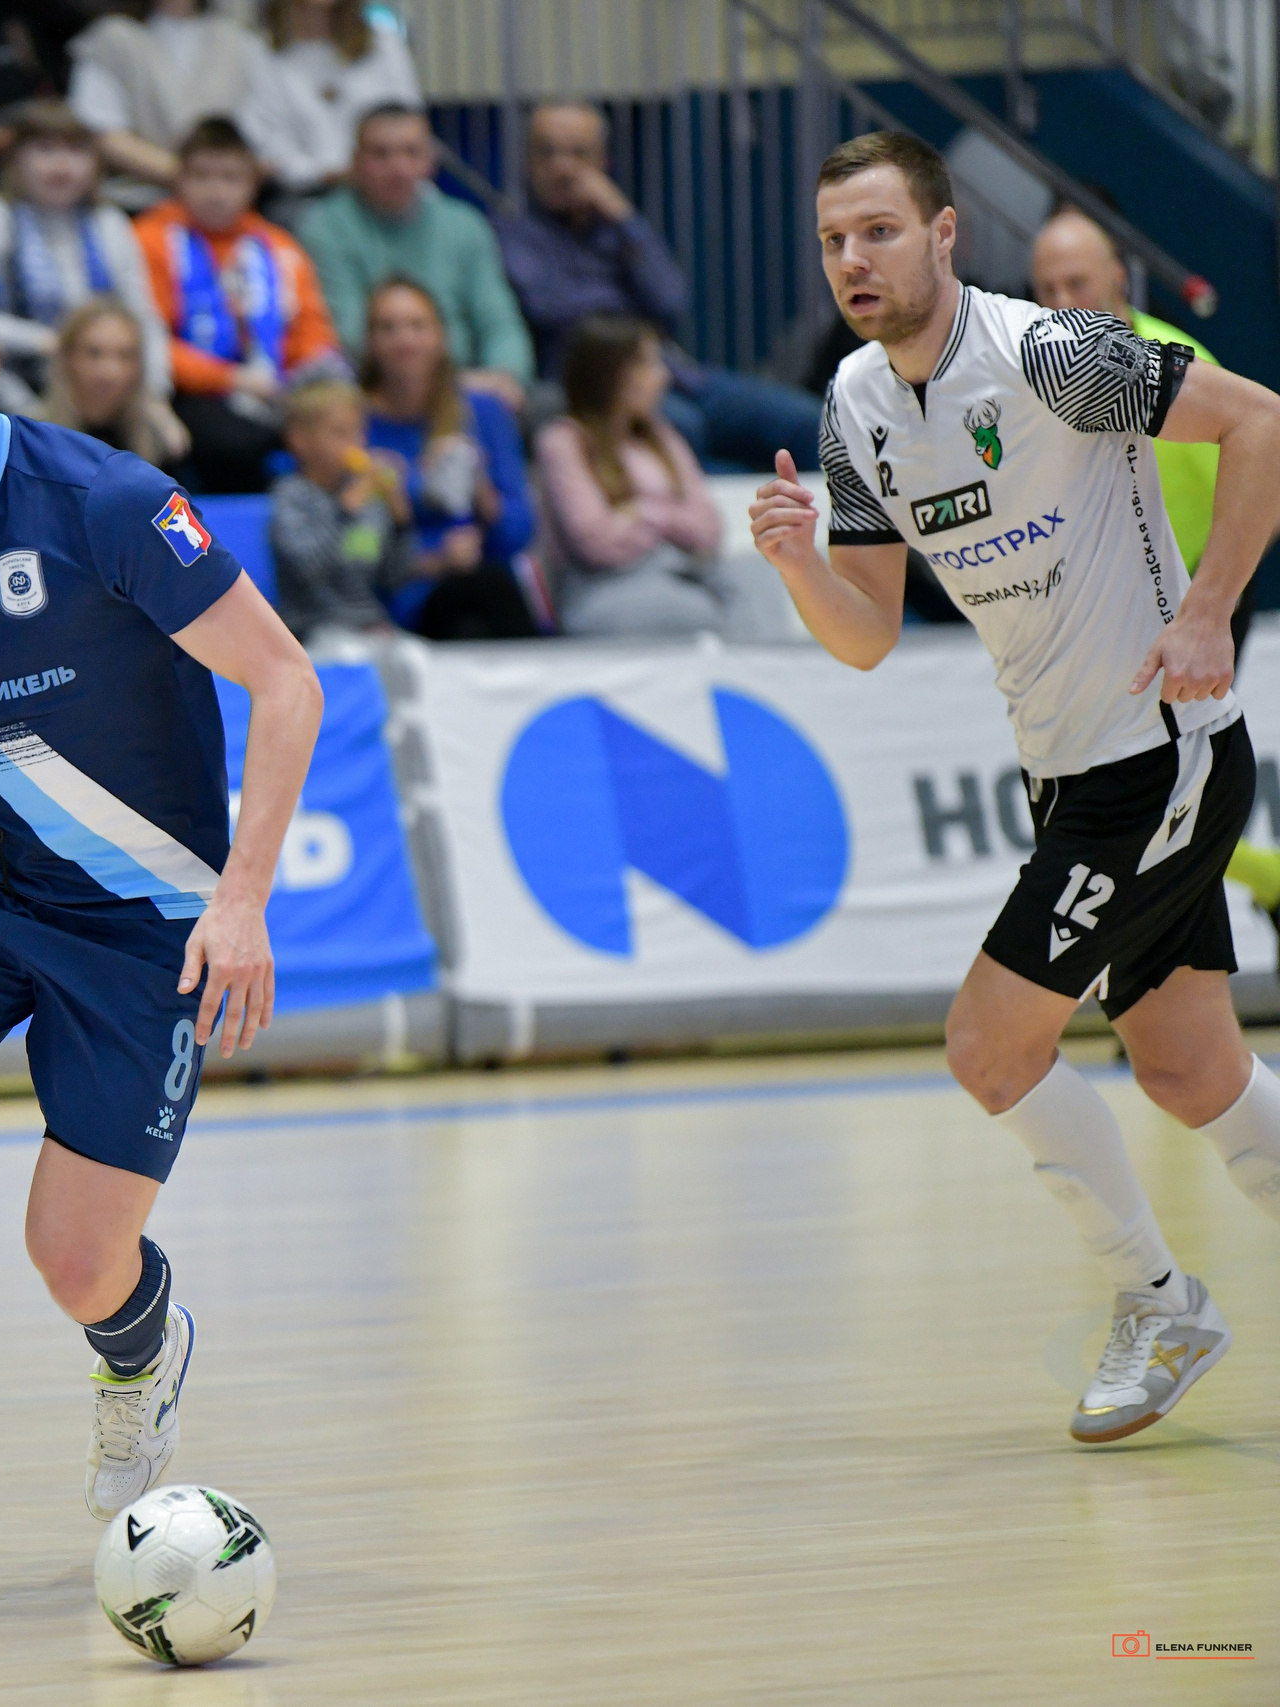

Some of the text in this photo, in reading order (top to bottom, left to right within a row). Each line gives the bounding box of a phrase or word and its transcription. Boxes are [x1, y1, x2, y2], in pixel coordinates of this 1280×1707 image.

[914, 486, 988, 531] PARI
[960, 556, 1067, 607] ORMAN346
[1138, 522, 1175, 625] ЕГОРОДСКАЯ
[1052, 863, 1115, 930] 12
[164, 1018, 196, 1102] 8
[145, 1125, 174, 1142] KELME
